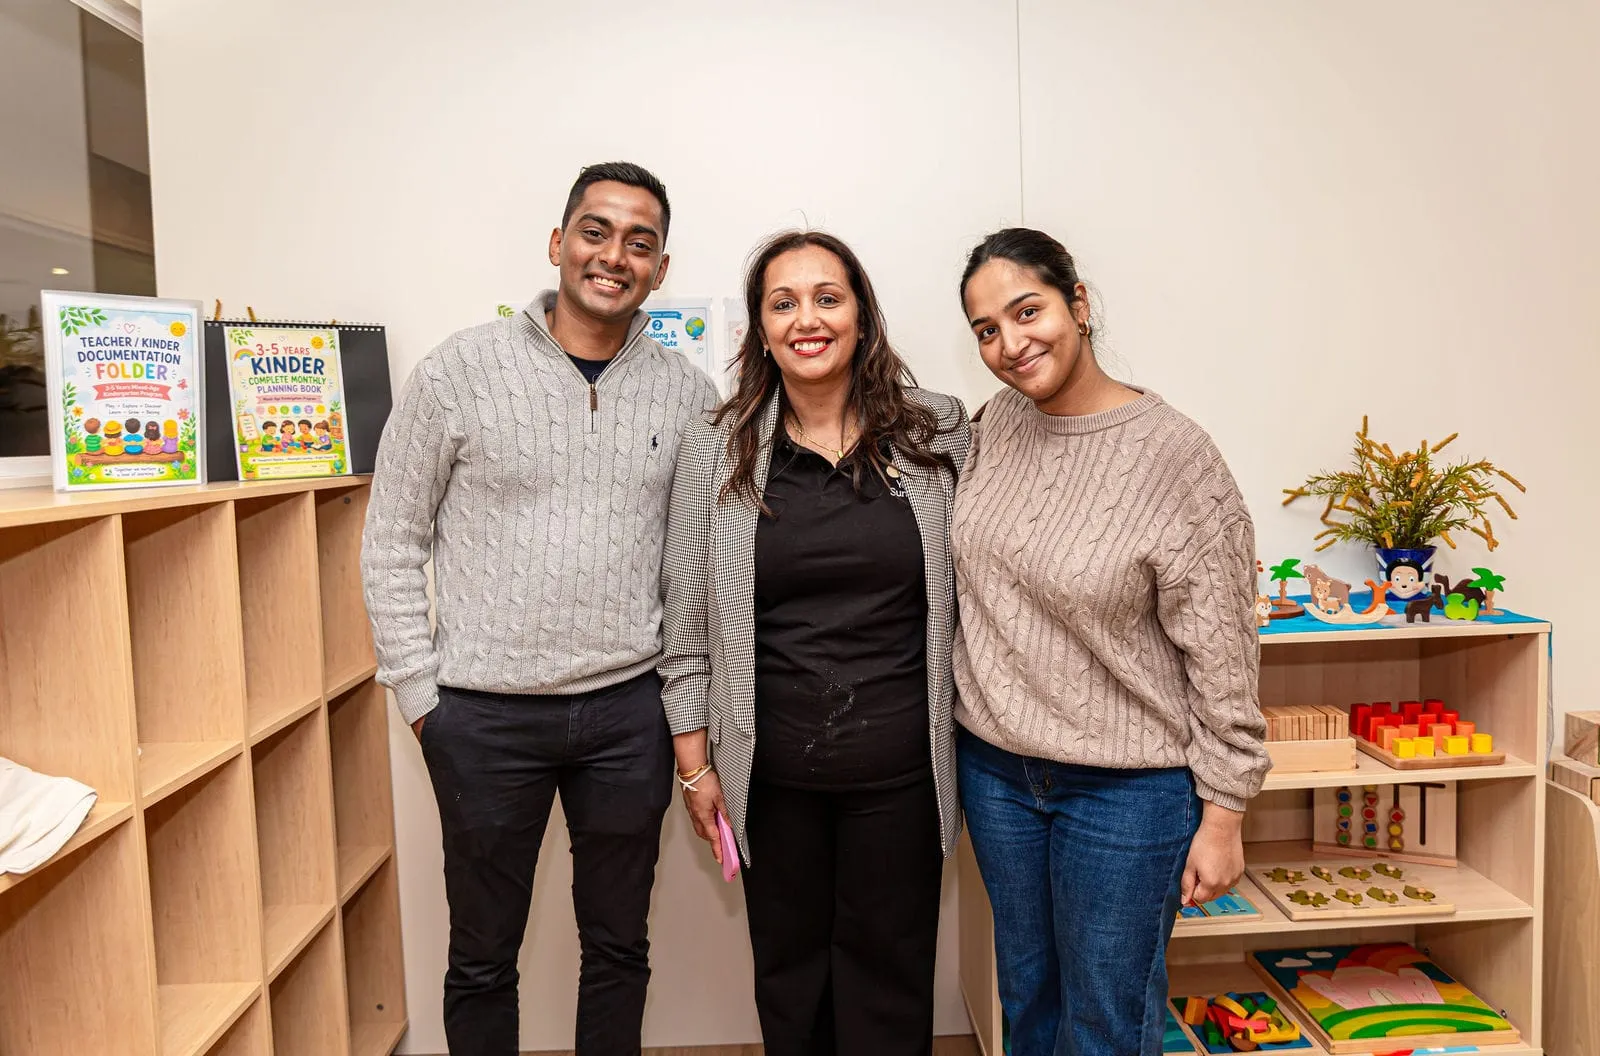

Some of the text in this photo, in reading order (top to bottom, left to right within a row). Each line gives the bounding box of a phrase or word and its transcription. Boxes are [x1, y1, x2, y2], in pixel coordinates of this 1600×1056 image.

[654, 321, 660, 329] 2
[671, 330, 677, 338] &
[80, 336, 132, 348] TEACHER
[142, 338, 180, 351] KINDER
[256, 343, 311, 356] 3-5 YEARS
[78, 350, 181, 364] DOCUMENTATION
[96, 363, 168, 380] FOLDER
[251, 356, 325, 375] KINDER
[248, 376, 327, 386] COMPLETE MONTHLY
[257, 385, 322, 394] PLANNING BOOK
